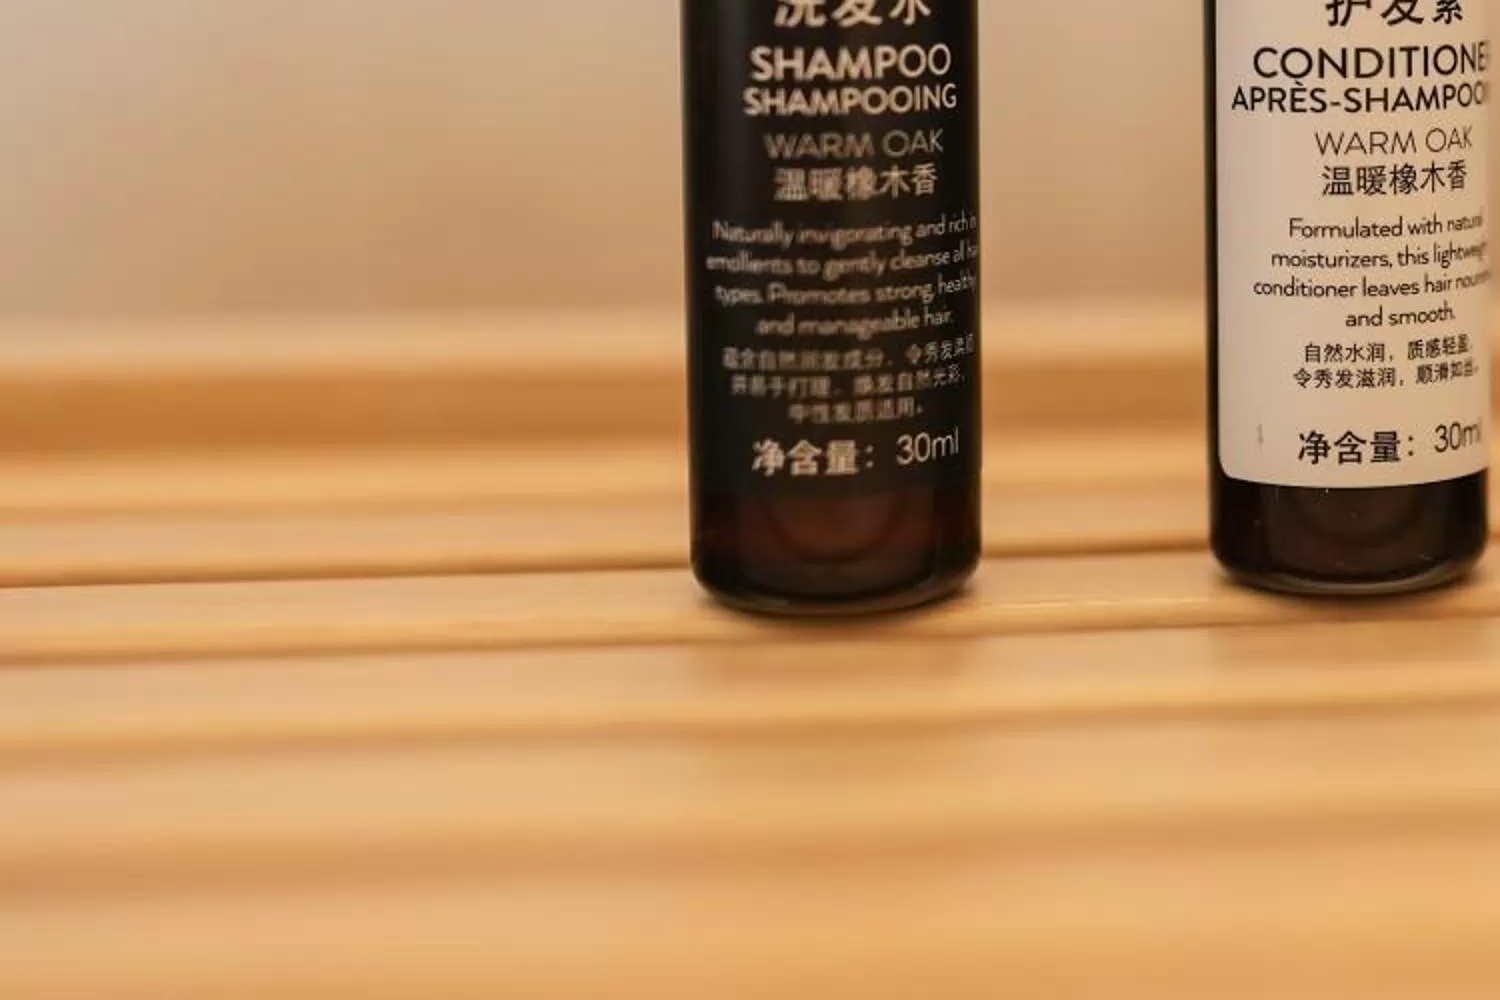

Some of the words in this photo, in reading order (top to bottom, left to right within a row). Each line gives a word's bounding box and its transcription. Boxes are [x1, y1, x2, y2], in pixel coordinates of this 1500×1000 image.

[750, 43, 951, 81] SHAMPOO
[1253, 39, 1489, 80] CONDITIONE
[743, 83, 957, 117] SHAMPOOING
[1231, 80, 1489, 113] APRÈS-SHAMPOO
[763, 131, 876, 160] WARM
[882, 127, 945, 157] OAK
[1314, 130, 1418, 156] WARM
[1425, 124, 1474, 154] OAK
[773, 160, 938, 202] 温暖橡木香
[1321, 159, 1468, 197] 温暖橡木香
[712, 218, 794, 249] Naturally
[915, 213, 945, 238] and
[948, 210, 968, 233] rich
[1289, 216, 1403, 239] Formulated
[1407, 212, 1443, 236] with
[795, 256, 821, 275] to
[822, 248, 888, 282] gently
[889, 246, 951, 271] cleanse
[1271, 250, 1393, 269] moisturizers,
[1397, 244, 1430, 267] this
[766, 280, 871, 305] Promotes
[1253, 276, 1358, 298] conditioner
[1362, 276, 1420, 297] leaves
[1424, 271, 1452, 293] hair
[755, 311, 795, 337] and
[797, 306, 920, 342] manageable
[1345, 304, 1383, 328] and
[895, 427, 960, 465] 30ml
